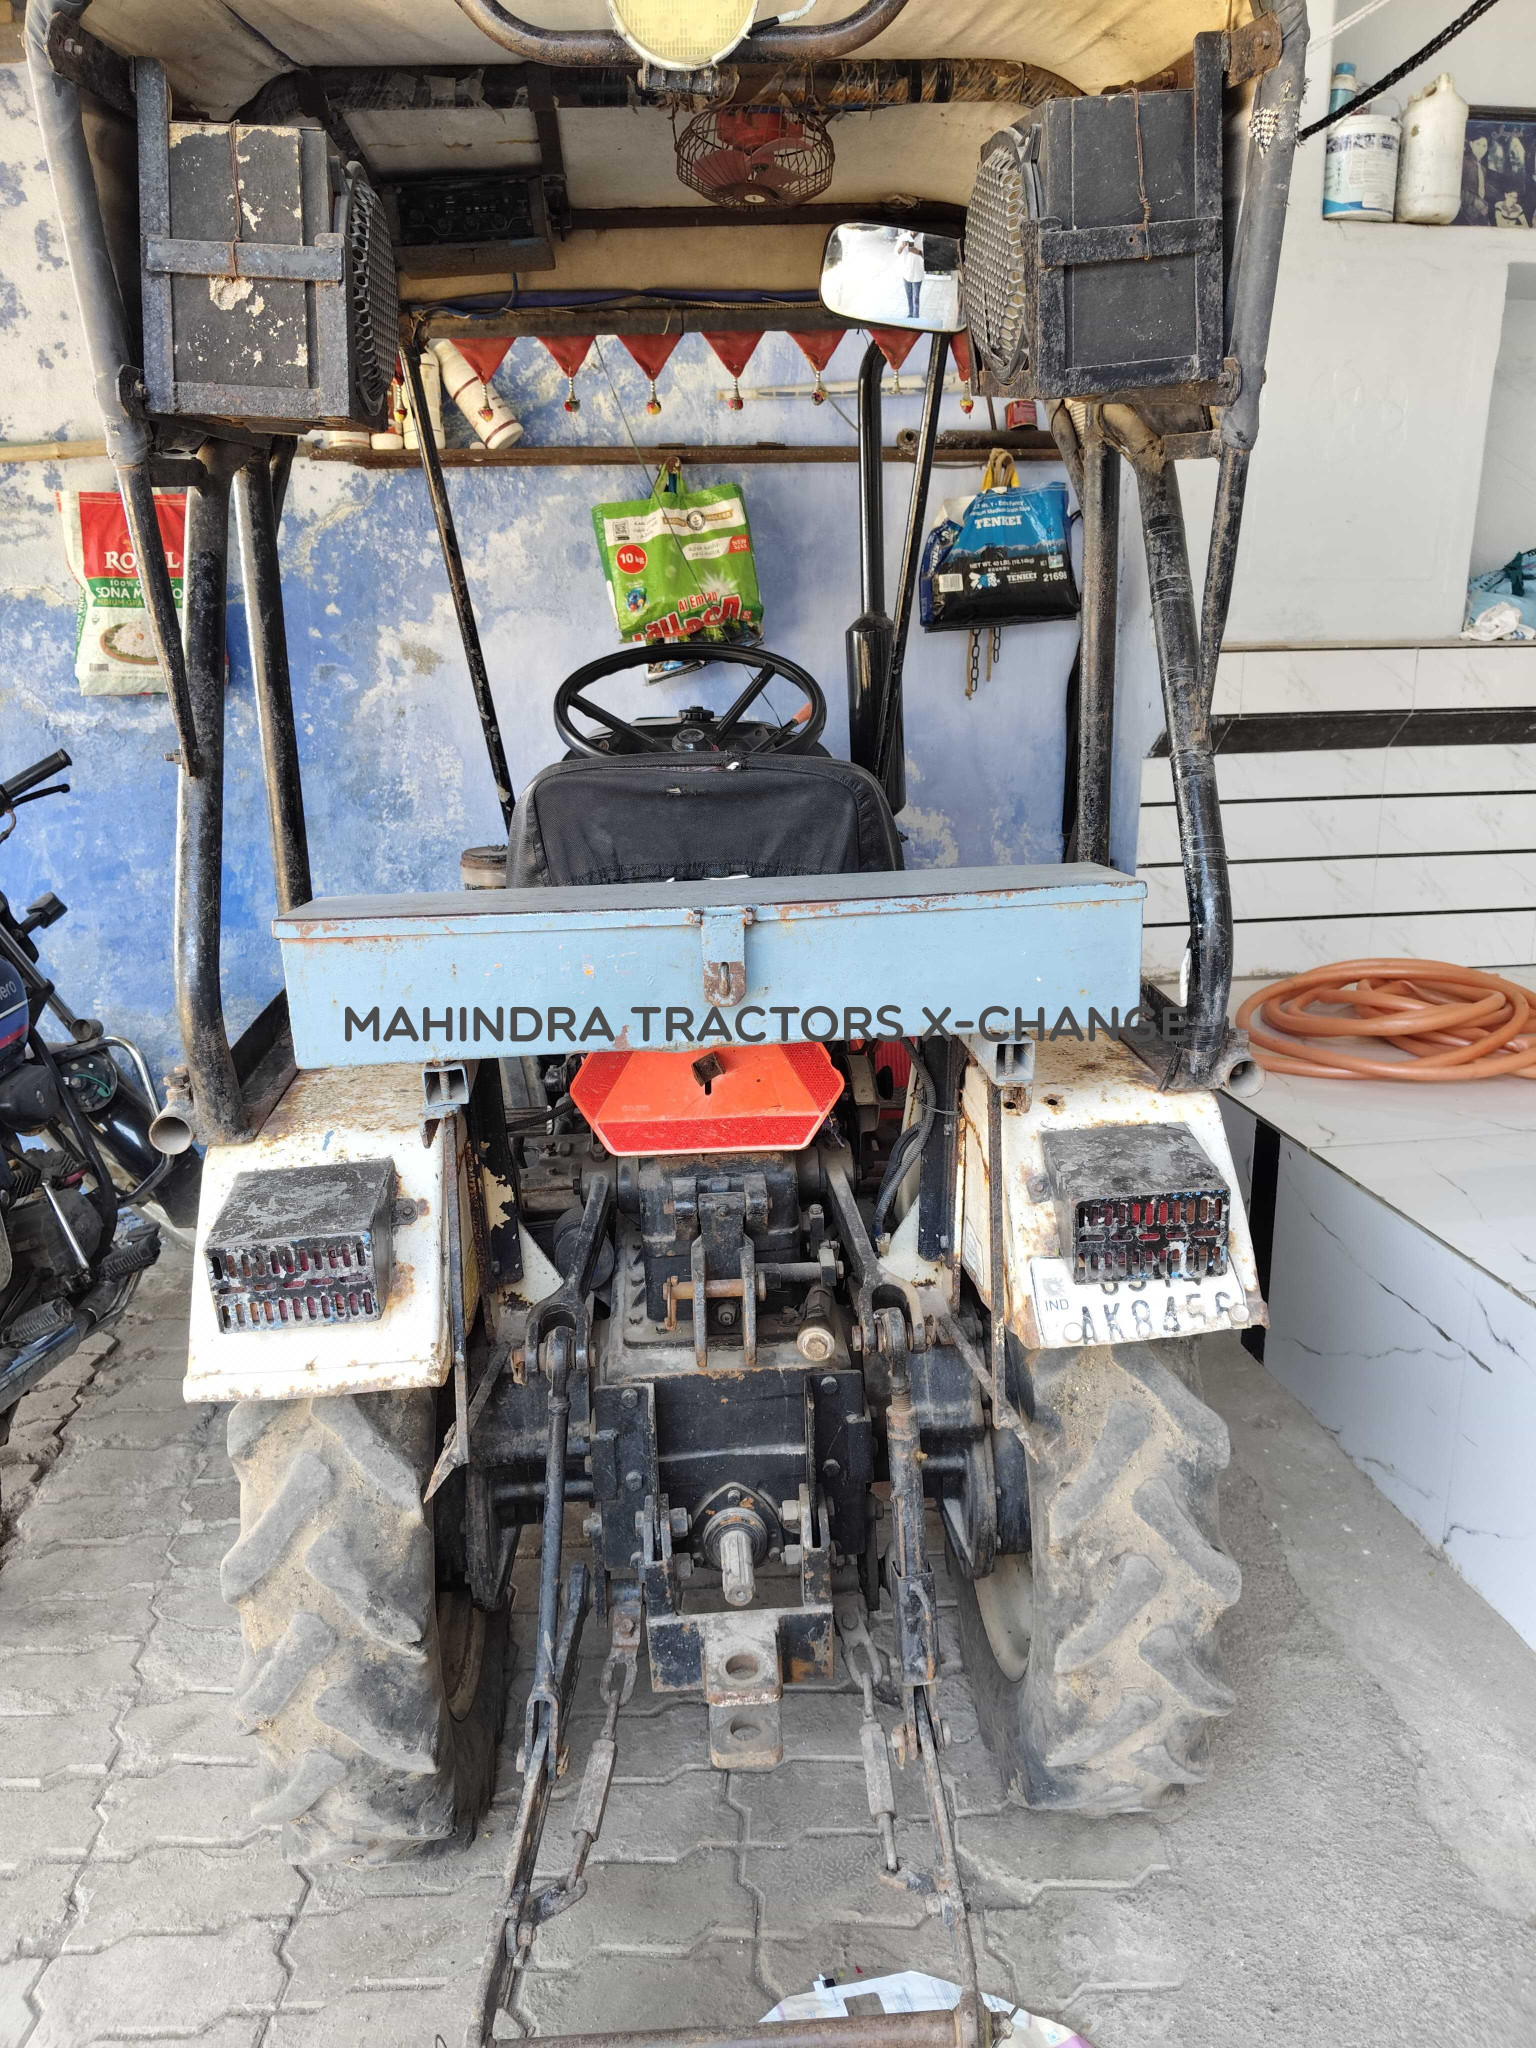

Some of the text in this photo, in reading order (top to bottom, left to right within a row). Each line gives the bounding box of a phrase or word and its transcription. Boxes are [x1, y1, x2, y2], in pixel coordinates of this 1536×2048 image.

[974, 515, 1023, 529] TENKEI
[104, 551, 180, 574] ROL
[619, 553, 645, 565] 10 kg
[109, 579, 134, 587] 100%
[1006, 572, 1037, 582] TENKEI
[95, 586, 131, 599] SONA
[678, 598, 689, 612] Al
[1045, 1298, 1069, 1312] IND
